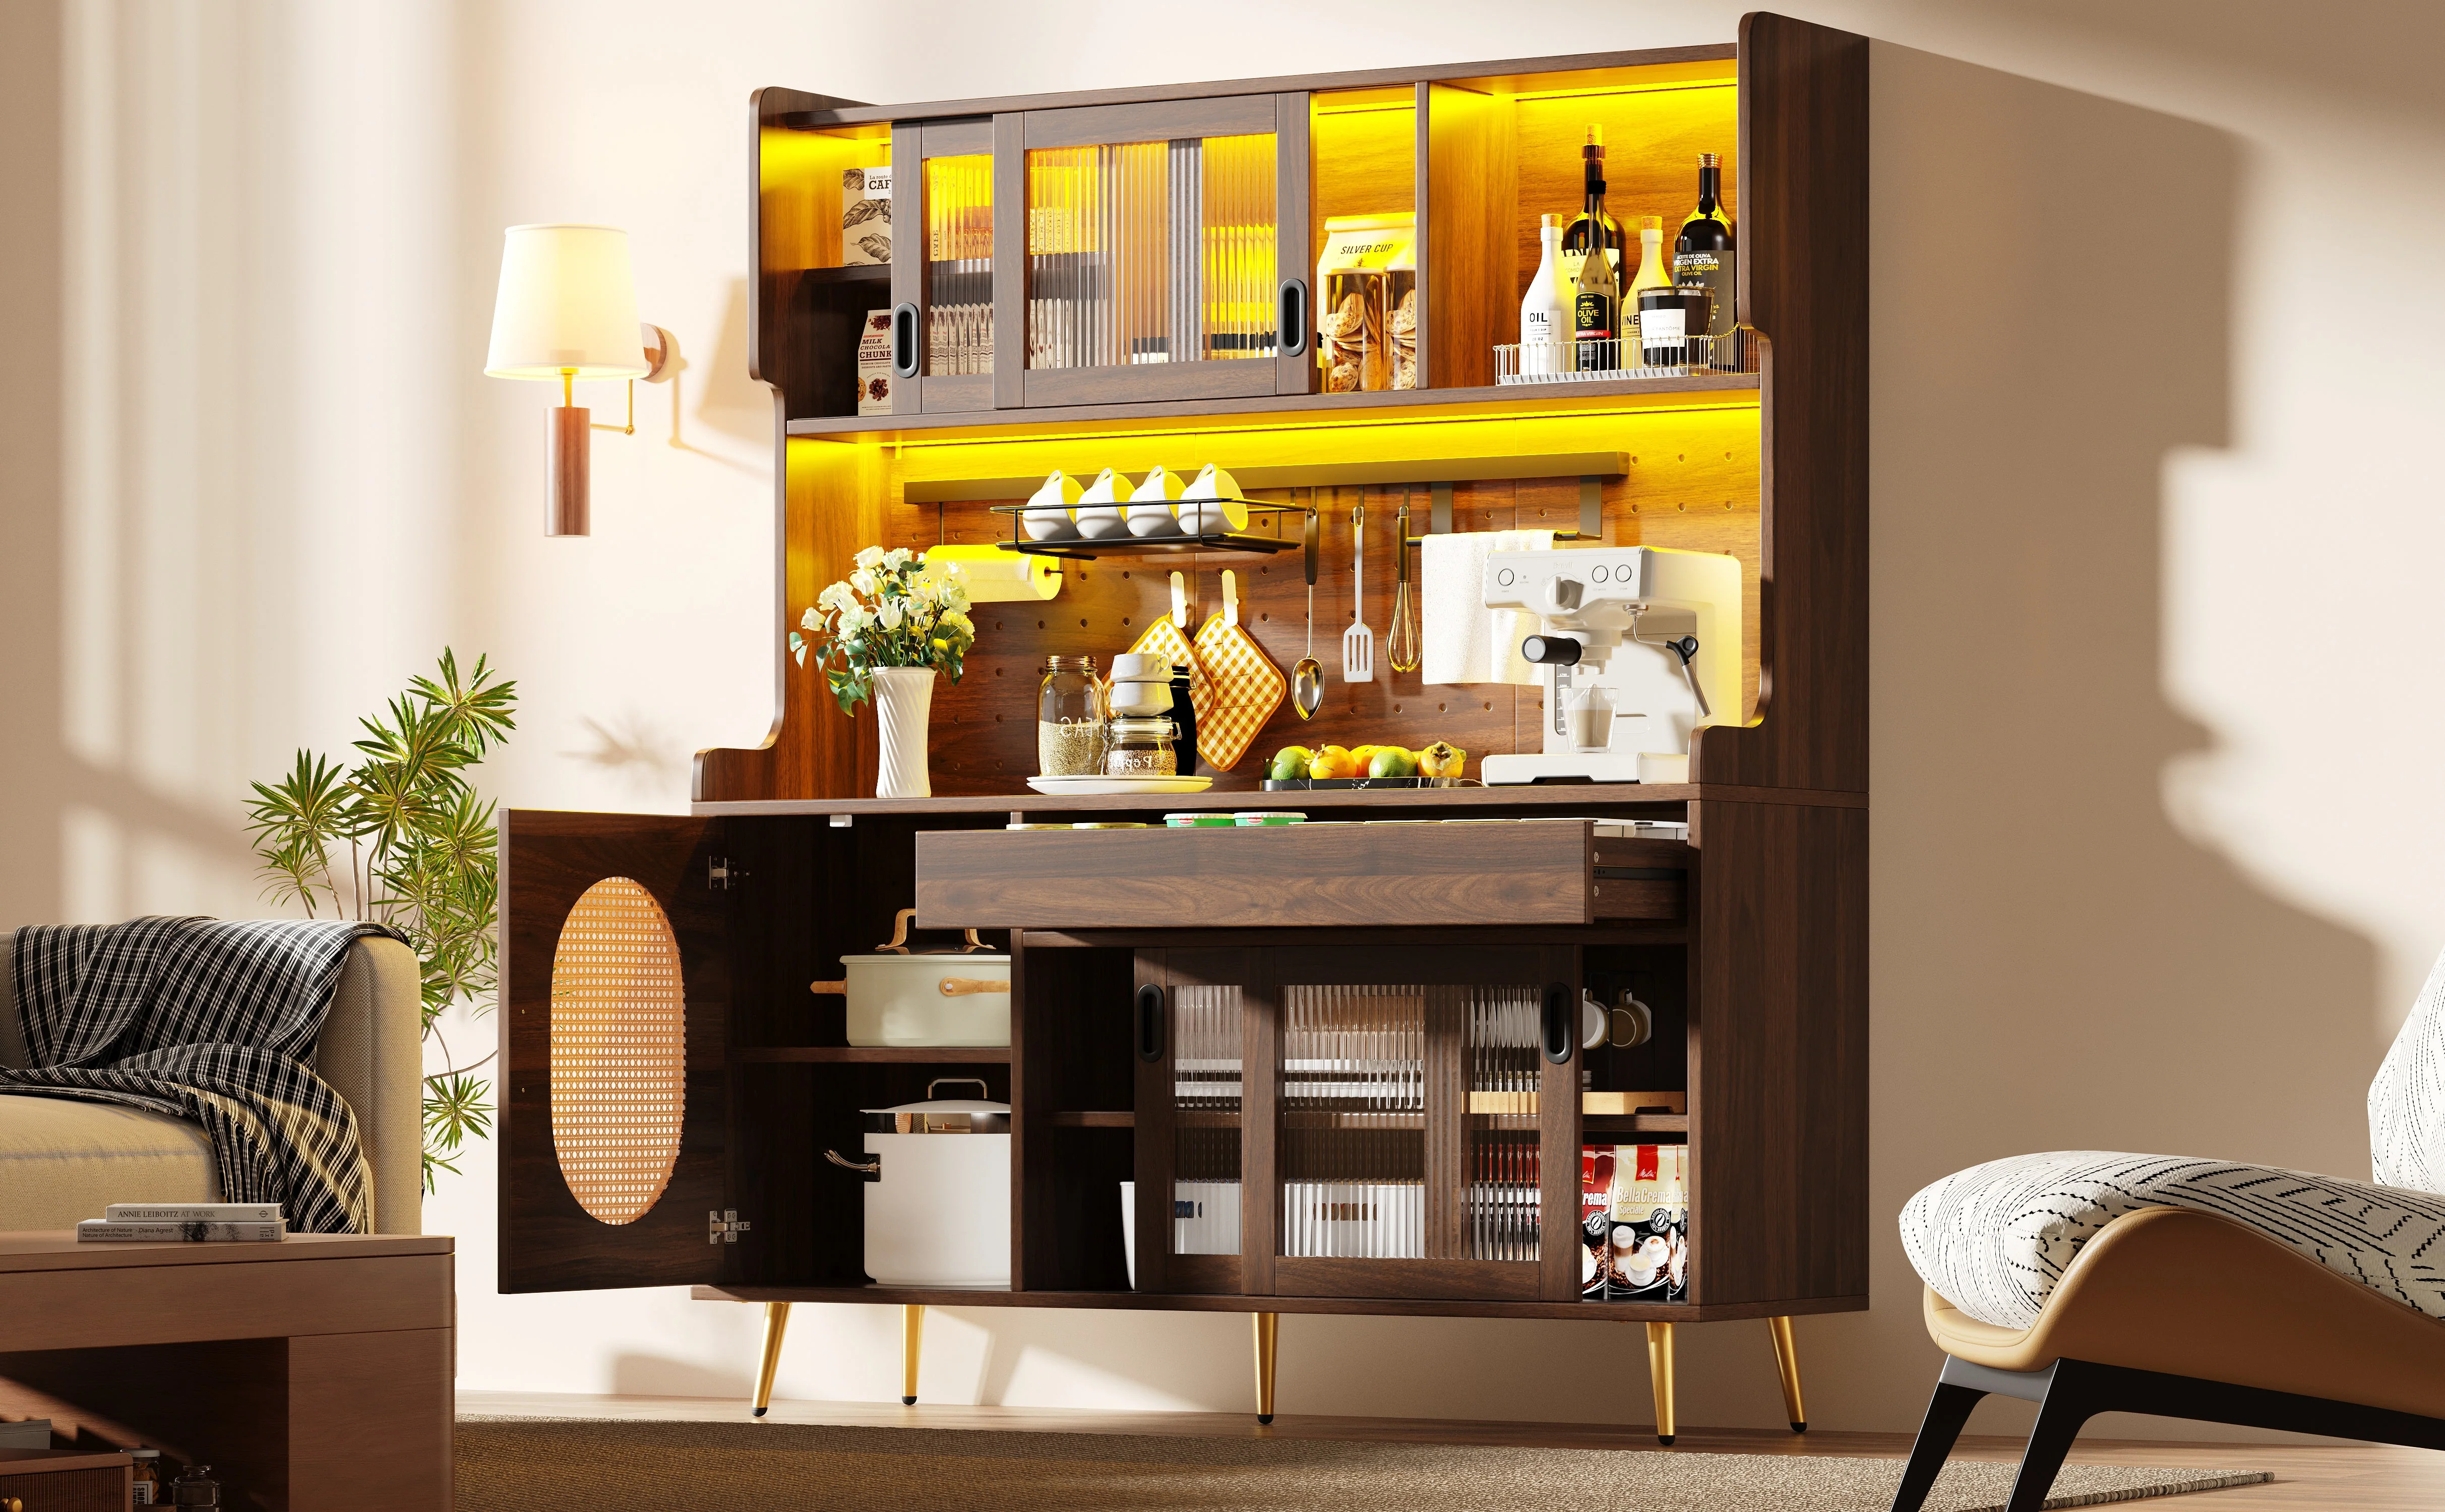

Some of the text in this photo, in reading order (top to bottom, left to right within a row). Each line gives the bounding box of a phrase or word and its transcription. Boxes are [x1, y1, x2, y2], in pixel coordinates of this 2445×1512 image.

[869, 179, 891, 190] CAF
[1340, 244, 1393, 254] SILVER CUP
[1530, 312, 1548, 322] OIL
[1622, 314, 1639, 326] VINE
[860, 350, 891, 358] CHUNK
[1582, 1192, 1608, 1206] rema
[1619, 1205, 1644, 1215] Speciale
